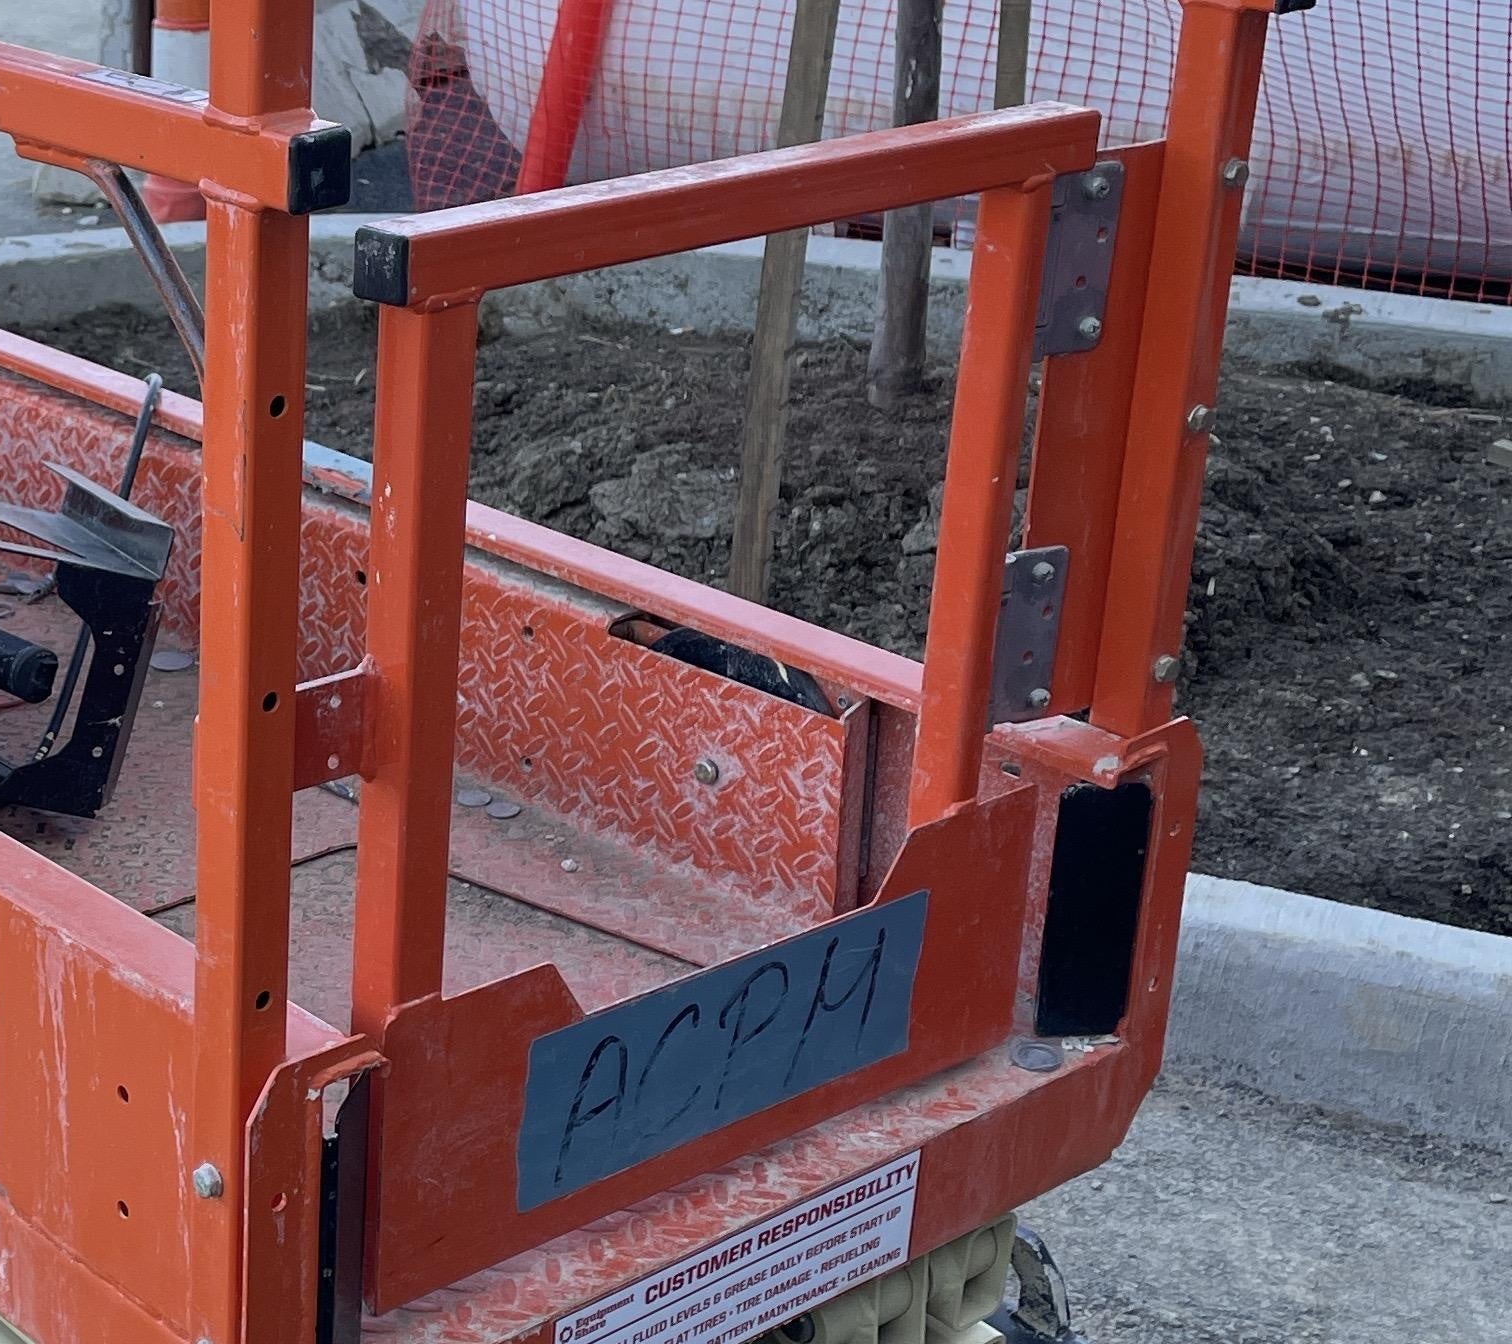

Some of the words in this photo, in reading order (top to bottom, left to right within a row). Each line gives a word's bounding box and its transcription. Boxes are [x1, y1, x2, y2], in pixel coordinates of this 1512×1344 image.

[554, 927, 887, 1189] ACPM
[644, 1236, 754, 1305] CUSTOMER
[757, 1160, 918, 1251] RESPONSIBILITY
[670, 1298, 711, 1327] LEVELS
[723, 1268, 769, 1301] GREASE
[770, 1252, 805, 1277] DAILY
[805, 1230, 848, 1260] BEFORE
[849, 1214, 884, 1239] START
[886, 1205, 902, 1222] UP
[574, 1317, 607, 1341] Share
[575, 1292, 635, 1330] Equipment
[692, 1313, 727, 1339] TIRES
[734, 1293, 766, 1316] TIRE
[764, 1270, 814, 1302] DAMAGE
[820, 1236, 882, 1274] REFUELING
[757, 1276, 840, 1326] MAINTENANCE
[847, 1247, 902, 1281] CLEANING
